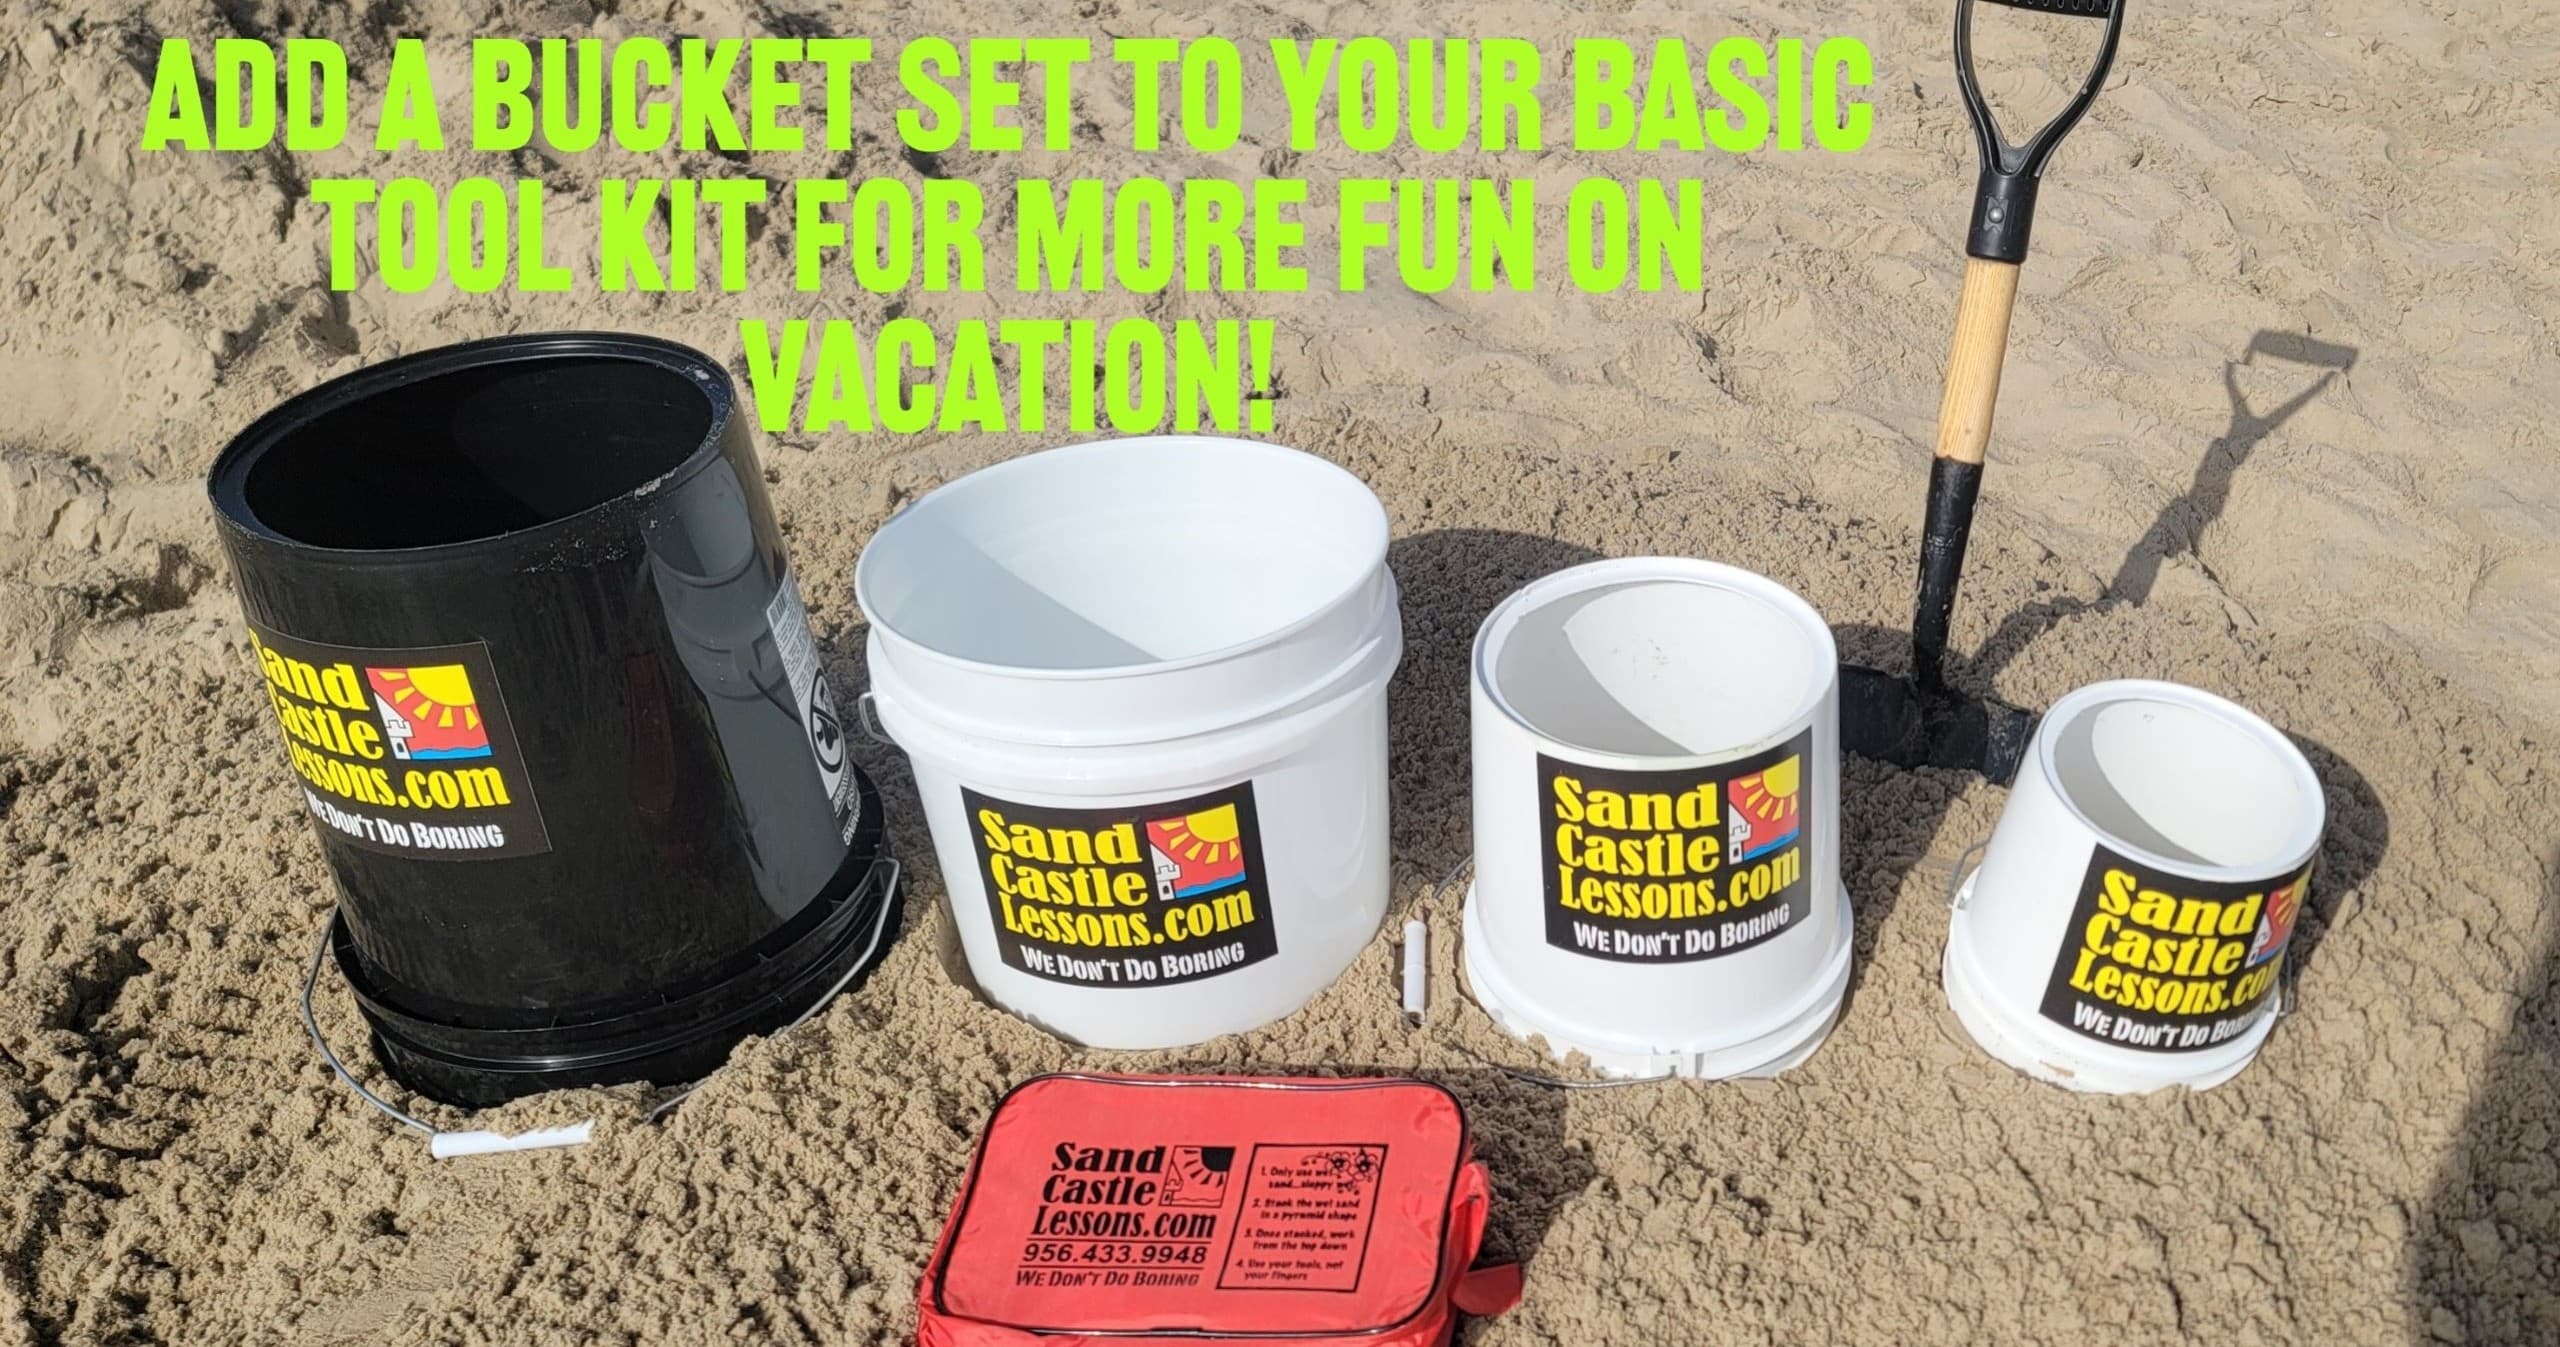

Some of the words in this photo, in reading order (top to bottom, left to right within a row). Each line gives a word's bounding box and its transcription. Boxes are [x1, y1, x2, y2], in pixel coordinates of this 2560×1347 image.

[282, 726, 511, 809] essons.com
[328, 804, 376, 841] DON'T
[375, 818, 410, 847] DO
[410, 822, 505, 850] BORING
[1553, 775, 1720, 831] Sand
[978, 809, 1143, 865] Sand
[1556, 823, 1720, 877] Castle
[991, 853, 1149, 907] Castle
[1558, 846, 1800, 920] Lessons.com
[2098, 868, 2264, 937] Sand
[998, 889, 1255, 948] Lessons.com
[1573, 920, 1610, 952] WE
[1614, 929, 1680, 956] DON'T
[1685, 928, 1716, 955] DO
[1720, 902, 1790, 949] BORING
[1020, 944, 1056, 976] WE
[1059, 954, 1120, 982] DON'T
[1124, 957, 1157, 982] DO
[1161, 941, 1246, 979] BORING
[2085, 912, 2245, 977] Castle
[2073, 1001, 2111, 1035] WE
[2112, 1016, 2180, 1047] DON'T
[2179, 1023, 2209, 1047] DO
[2209, 1010, 2256, 1043] BOR
[1052, 1142, 1166, 1173] Sand
[1270, 1166, 1293, 1177] Only
[1043, 1174, 1156, 1206] Castle
[1336, 1199, 1360, 1208] sand
[1031, 1205, 1216, 1238] Lessons.com
[1023, 1243, 1207, 1263] 956.433.9948
[1016, 1270, 1045, 1286] WE
[1049, 1271, 1101, 1286] DON'T
[1104, 1271, 1129, 1286] DO
[1132, 1272, 1200, 1287] BORING
